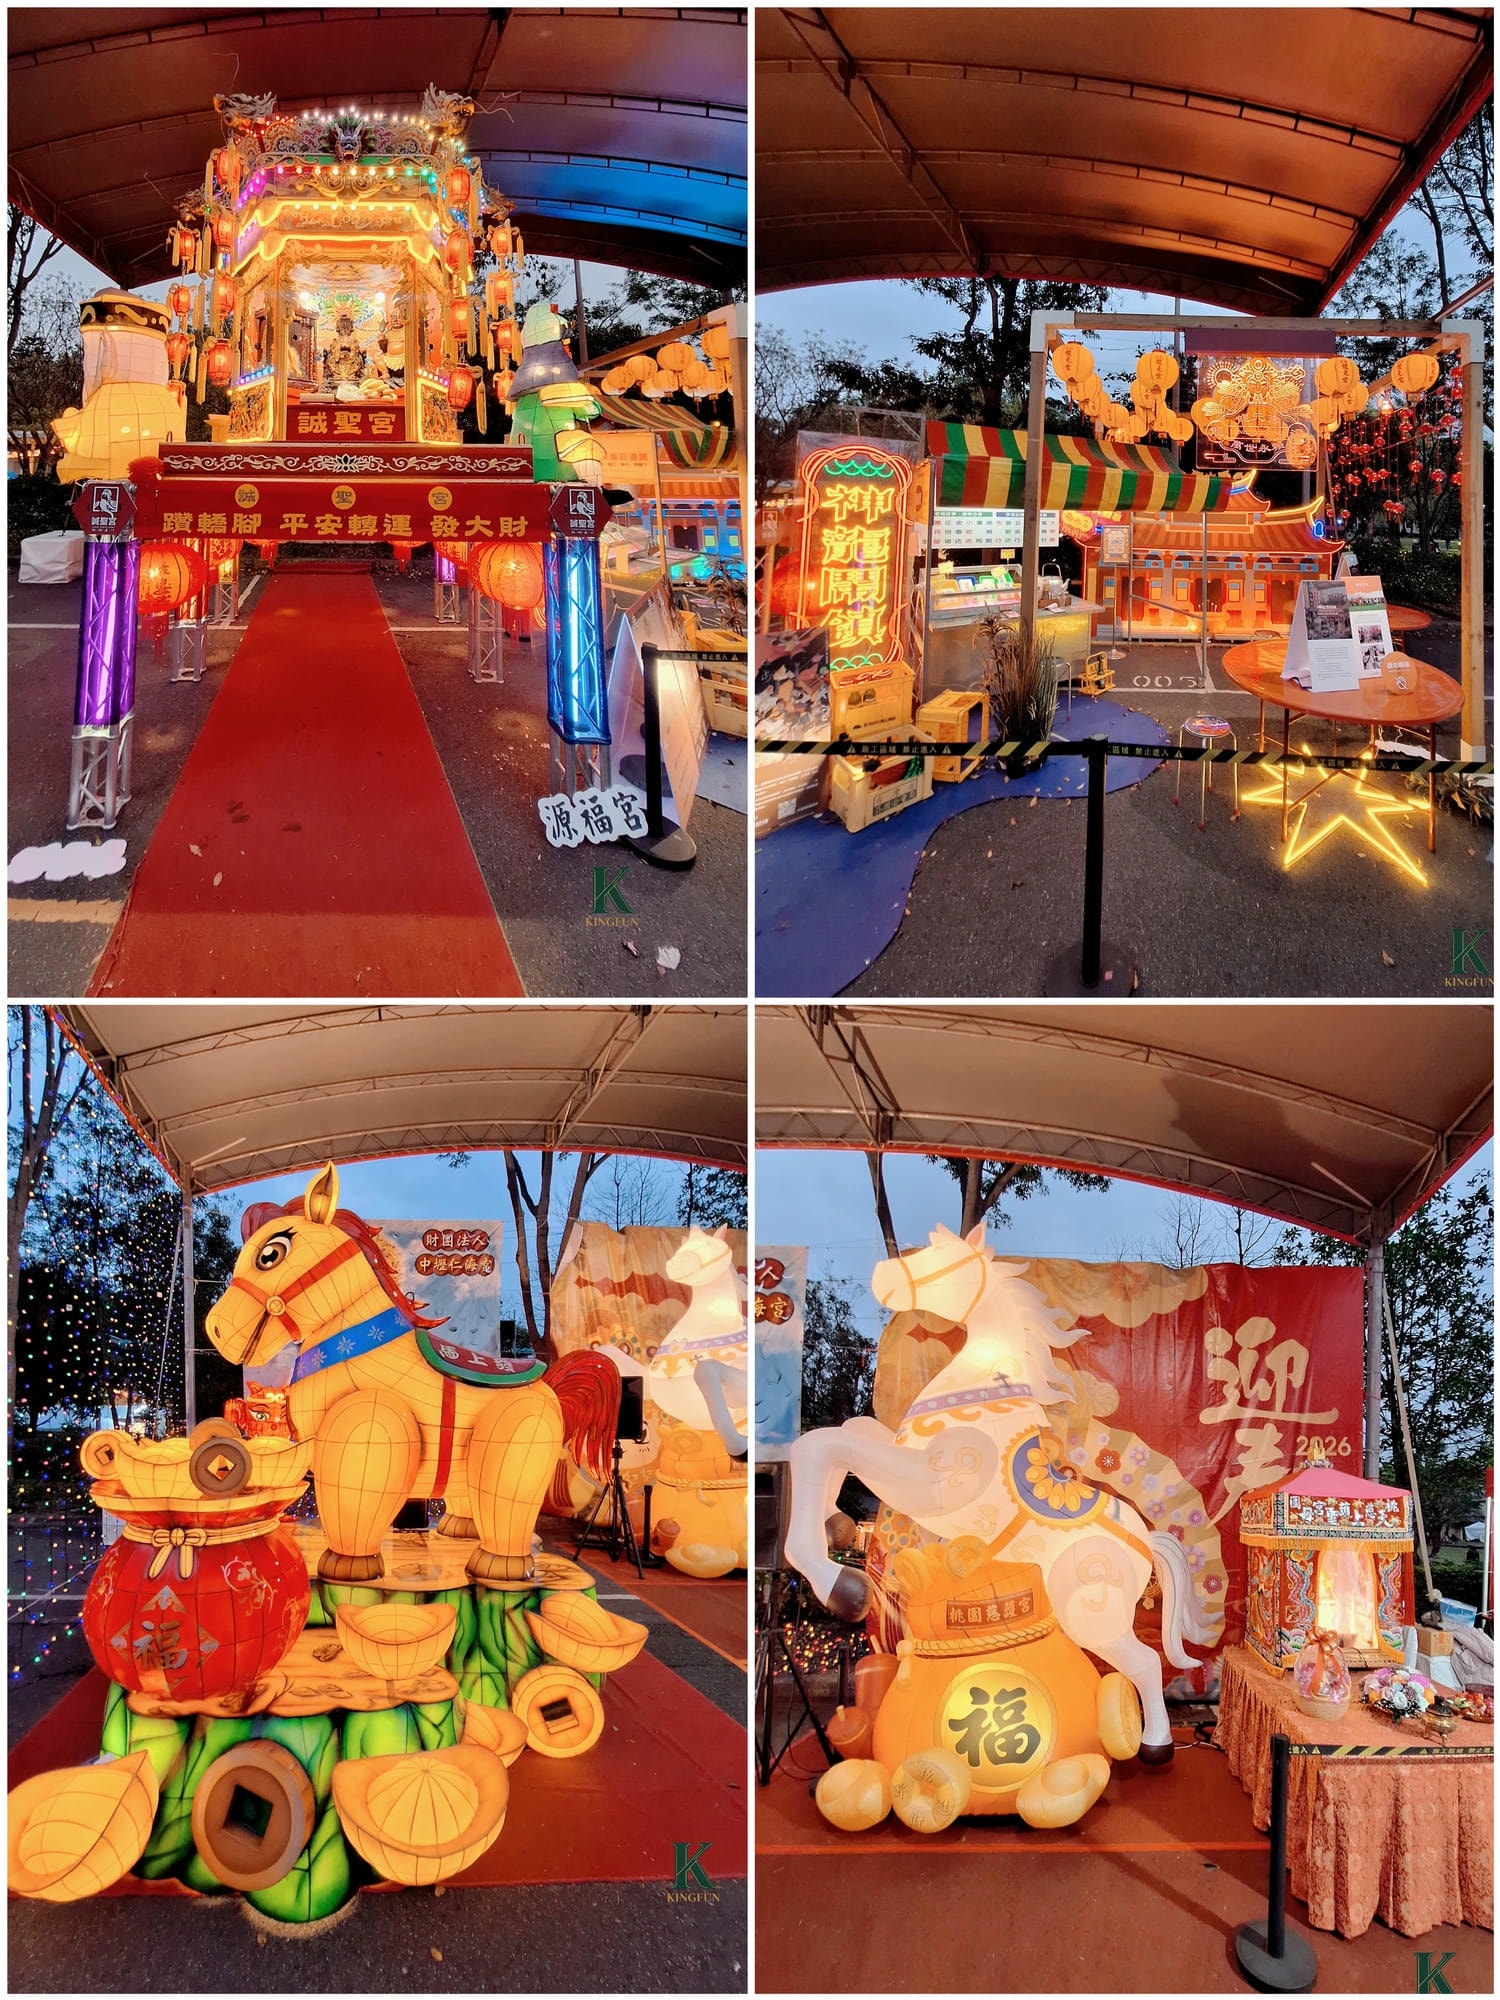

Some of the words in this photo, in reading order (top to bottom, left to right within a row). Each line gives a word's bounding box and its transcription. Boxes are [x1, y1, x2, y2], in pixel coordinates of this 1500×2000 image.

[298, 411, 396, 434] 誠聖宮
[432, 492, 449, 505] 宮
[280, 513, 413, 537] 平安轉運
[430, 515, 528, 537] 發大財
[1135, 747, 1169, 757] 禁止進入
[545, 792, 642, 840] 源福宮
[426, 1233, 486, 1248] 財團法人
[420, 1257, 493, 1273] 中壢仁海宮
[439, 1343, 516, 1373] 馬上發
[1296, 1435, 1352, 1457] 2026
[949, 1597, 1032, 1624] 桃園慈護宮
[134, 1620, 188, 1670] 福
[948, 1686, 1041, 1768] 福
